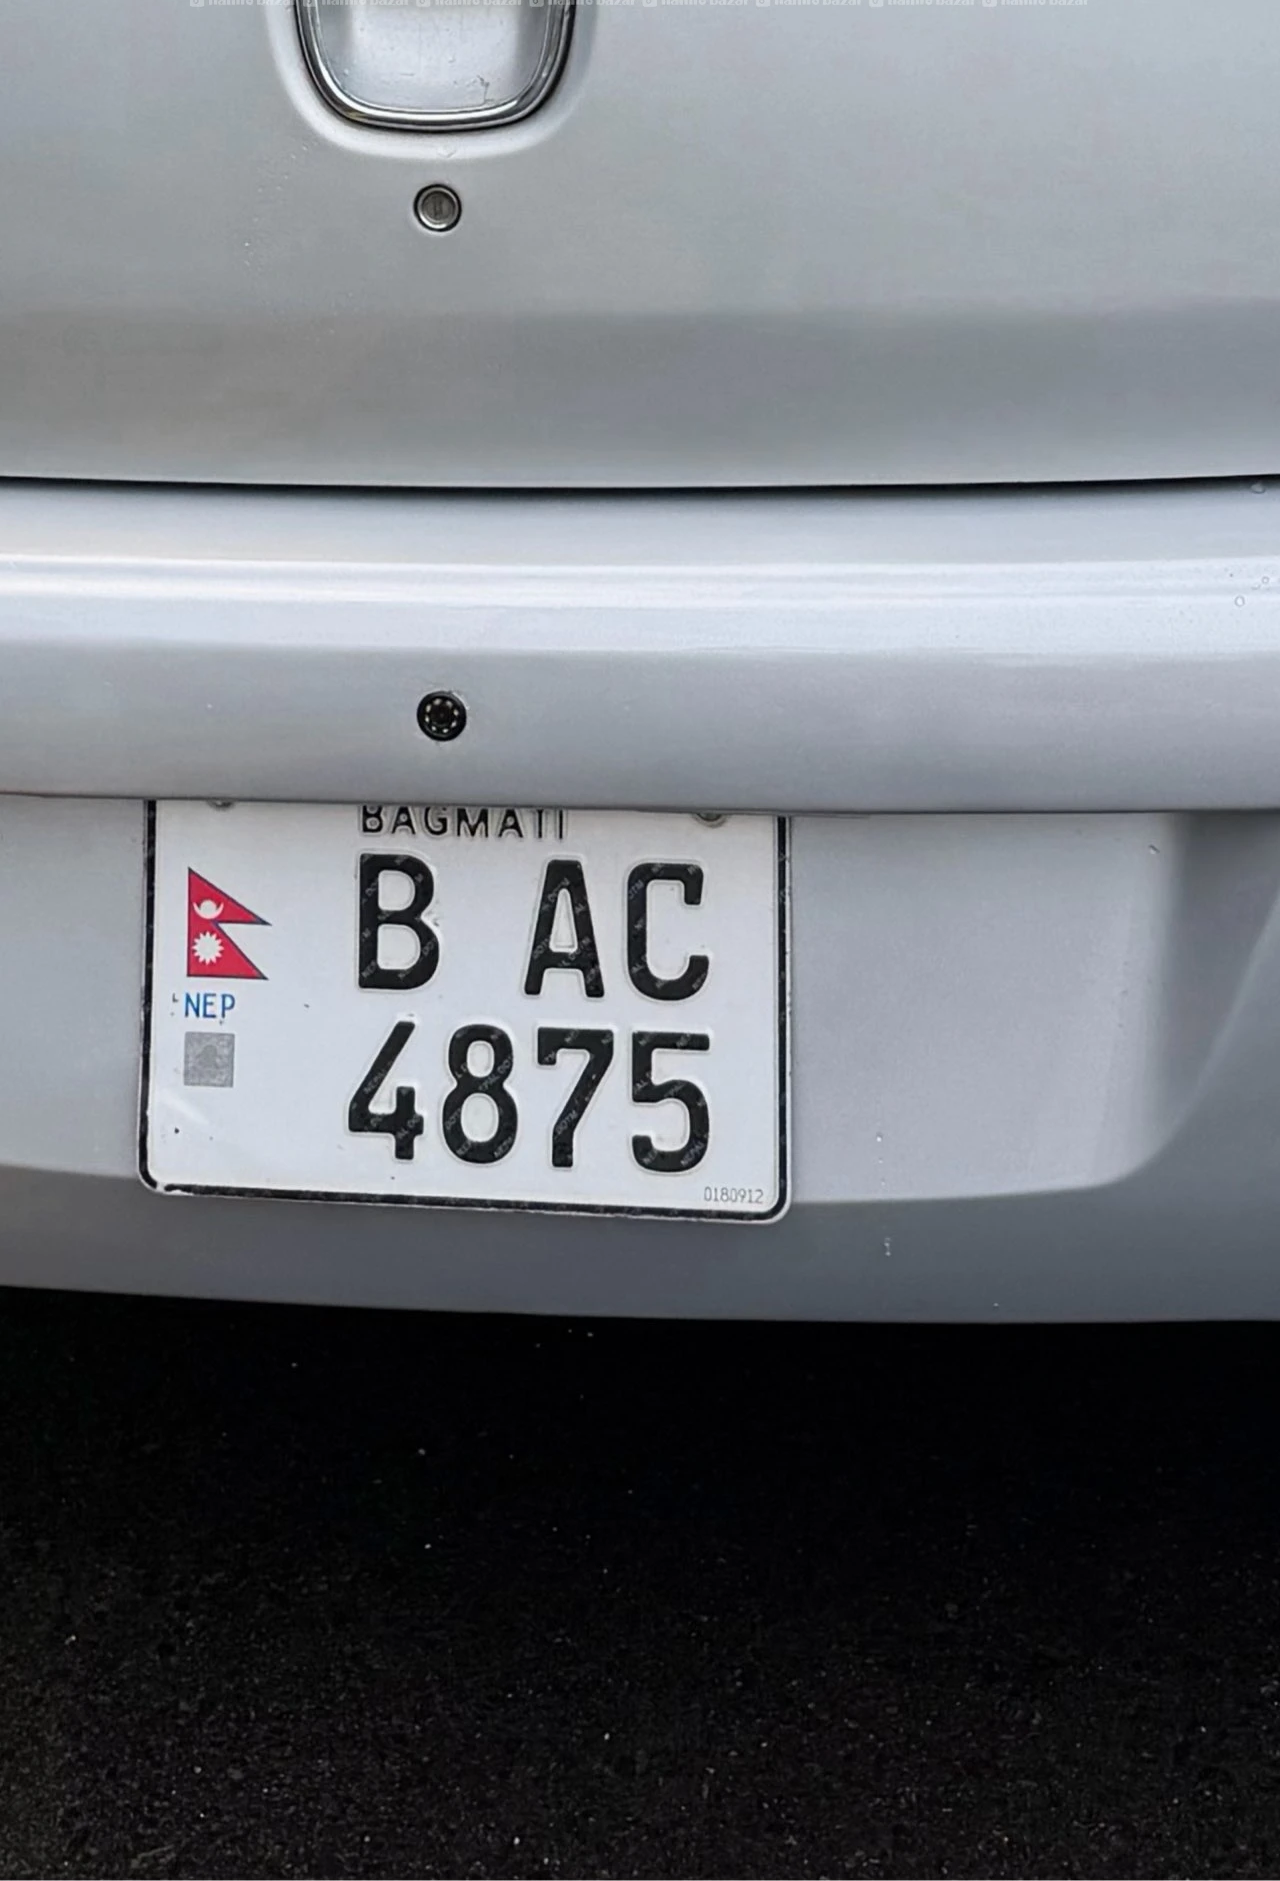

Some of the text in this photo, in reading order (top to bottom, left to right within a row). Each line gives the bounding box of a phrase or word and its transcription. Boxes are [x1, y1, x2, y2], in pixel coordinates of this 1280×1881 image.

[362, 804, 564, 840] BAGMATI
[358, 853, 710, 1002] B AC
[184, 992, 236, 1019] NEP
[348, 1020, 710, 1173] 4875
[703, 1186, 764, 1204] 0180912
